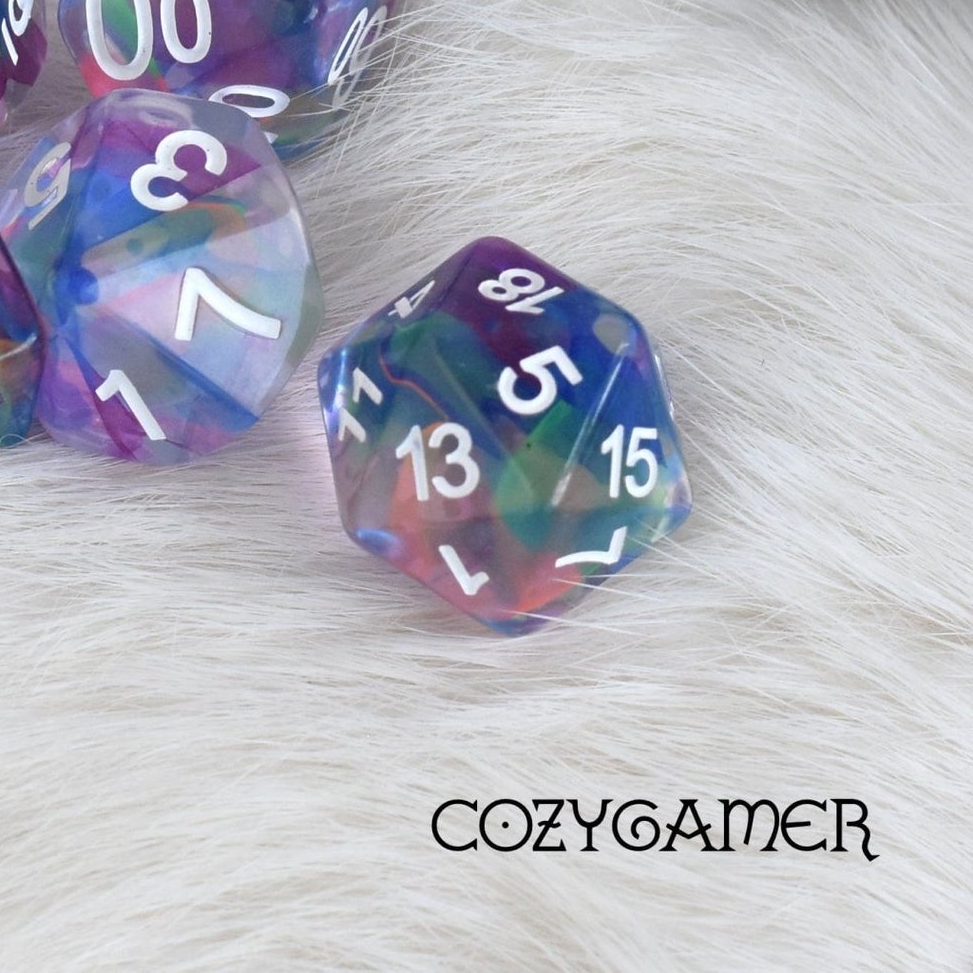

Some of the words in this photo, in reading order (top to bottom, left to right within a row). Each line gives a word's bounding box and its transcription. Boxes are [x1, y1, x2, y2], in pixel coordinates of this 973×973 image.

[130, 129, 227, 212] 3
[174, 267, 281, 341] 7
[478, 268, 566, 315] 18
[95, 369, 167, 441] 1
[497, 345, 583, 416] 5
[395, 422, 480, 502] 13
[600, 424, 659, 499] 15
